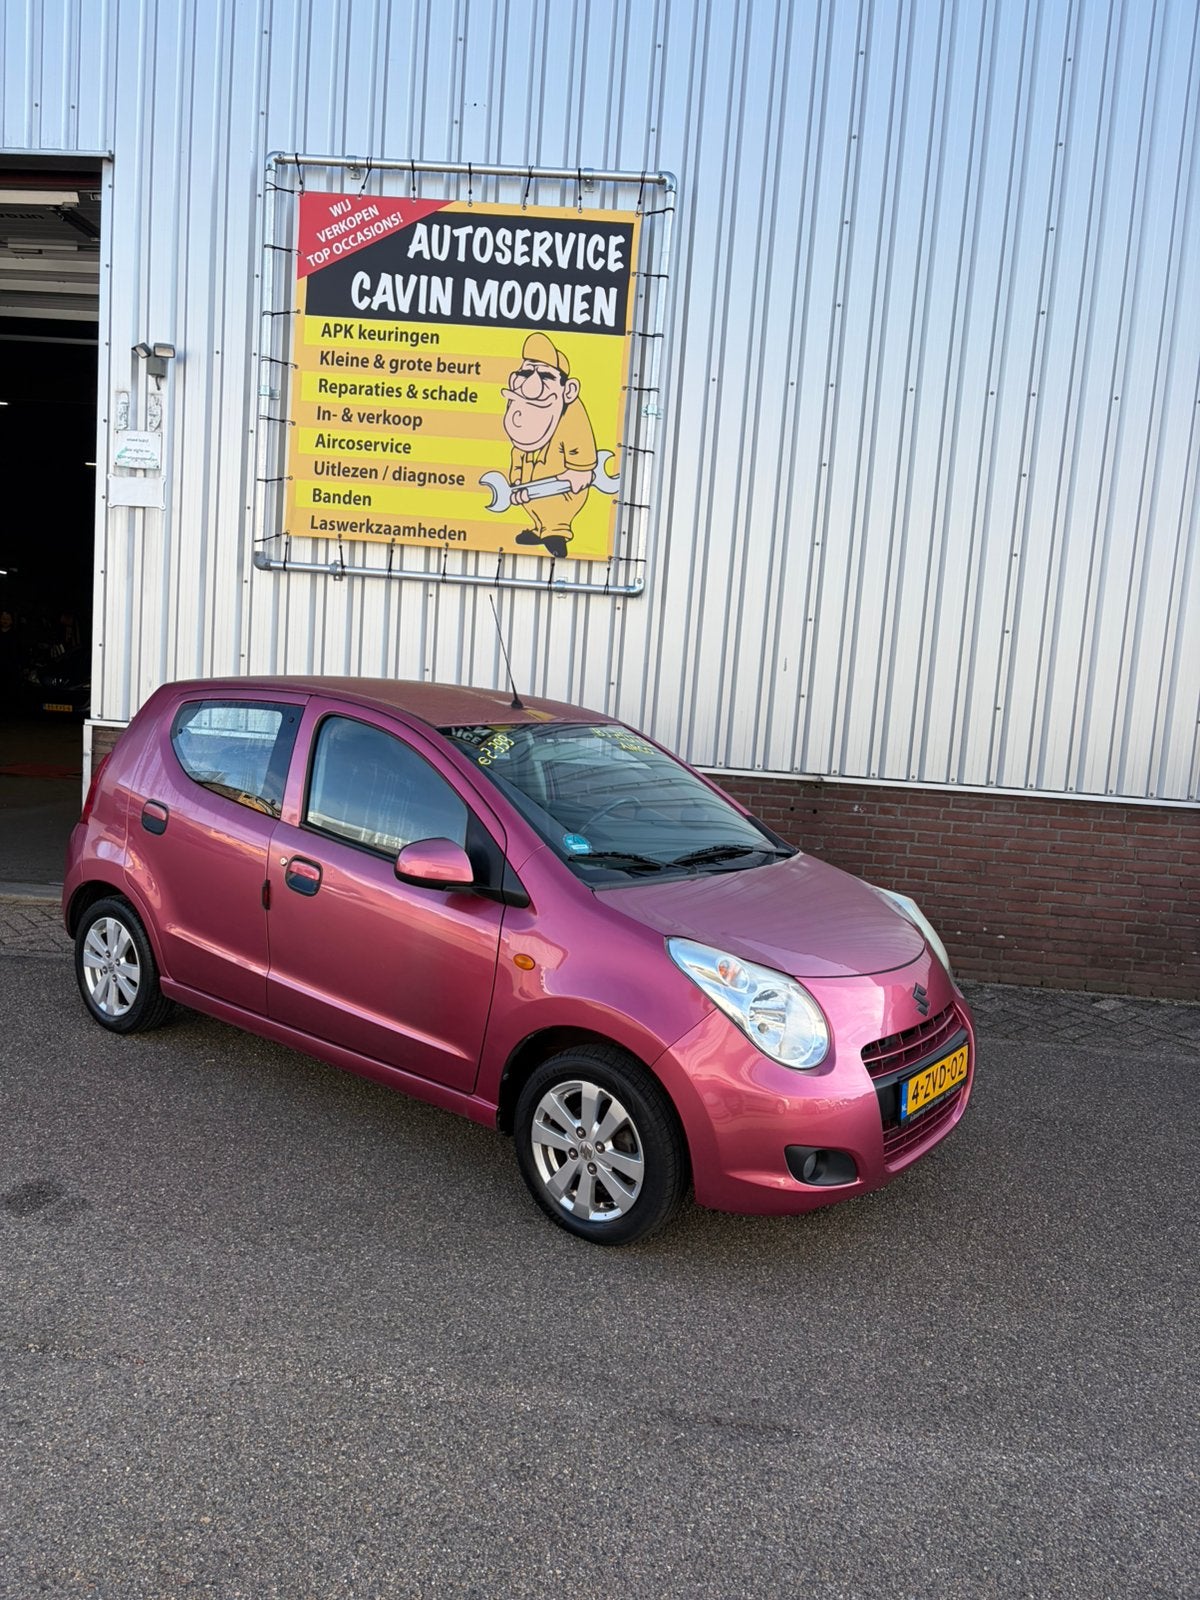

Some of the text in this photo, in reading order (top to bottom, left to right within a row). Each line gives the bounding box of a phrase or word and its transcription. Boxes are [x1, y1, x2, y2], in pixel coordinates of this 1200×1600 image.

[328, 199, 352, 217] WIJ
[316, 204, 380, 243] VERKOPEN
[306, 211, 404, 267] TOP OCCASIONS!
[407, 222, 626, 272] AUTOSERVICE
[350, 270, 618, 327] CAVIN MOONEN
[321, 322, 440, 347] APK keuringen
[319, 350, 481, 375] Kleine & grote beurt
[318, 378, 478, 403] Reparaties & schade
[316, 405, 423, 430] In- & verkoop
[315, 433, 412, 454] Aircoservice
[314, 460, 465, 486] Uitlezen / diagnose
[312, 488, 372, 506] Banden
[310, 514, 467, 541] Laswerkzaamheden
[912, 1052, 965, 1105] 4-ZVD-02
